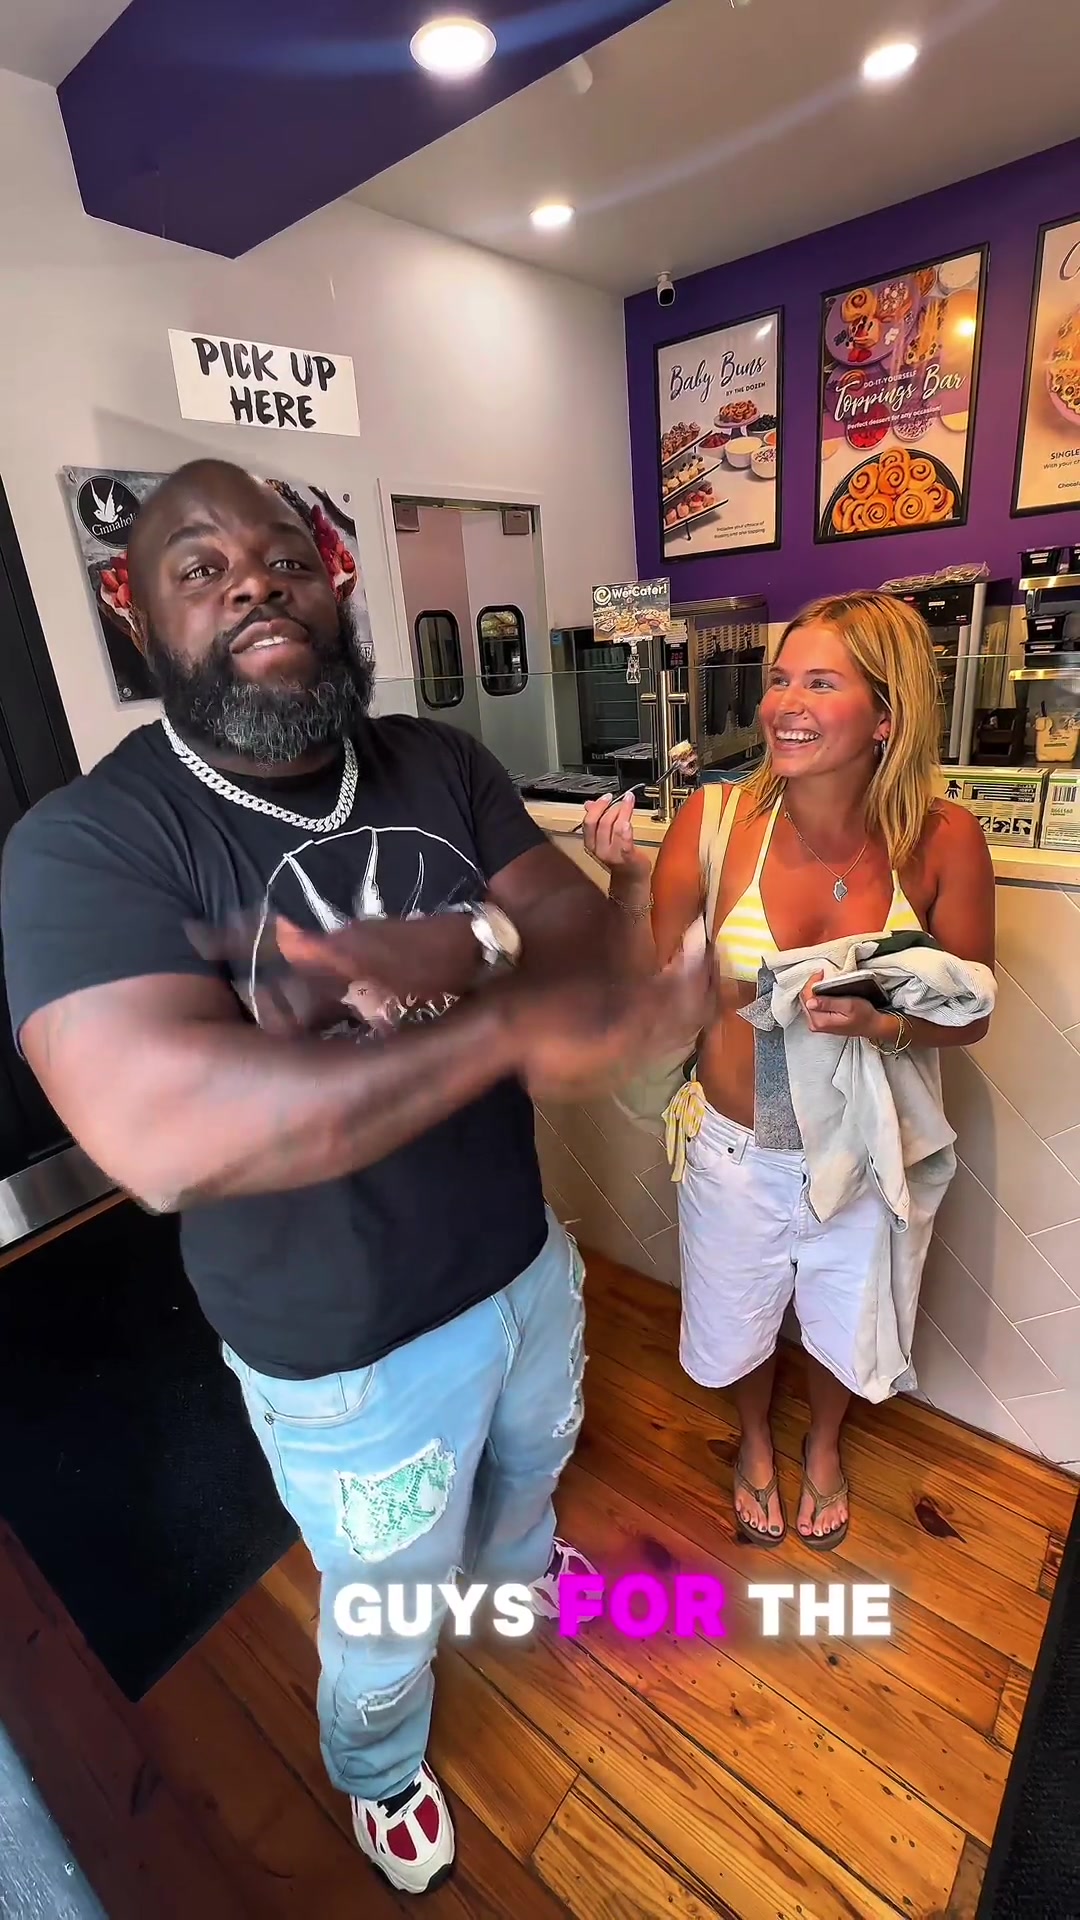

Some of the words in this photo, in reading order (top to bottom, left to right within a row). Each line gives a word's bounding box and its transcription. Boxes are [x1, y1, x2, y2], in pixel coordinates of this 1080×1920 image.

[191, 337, 278, 381] PICK
[290, 351, 336, 391] UP
[670, 359, 714, 403] Baby
[721, 350, 766, 387] Buns
[746, 381, 766, 391] DOZEN
[863, 370, 917, 389] DO-IT-YOURSELF
[834, 380, 917, 421] Toppings
[922, 363, 966, 400] Bar
[230, 386, 316, 428] HERE
[847, 420, 868, 430] Perfect
[868, 415, 891, 426] dessert
[891, 413, 900, 421] for
[900, 411, 912, 420] any
[913, 404, 942, 417] occasion!
[1050, 449, 1080, 460] SINGLE
[1058, 460, 1072, 468] your
[611, 586, 632, 600] We
[632, 583, 667, 598] Cater!
